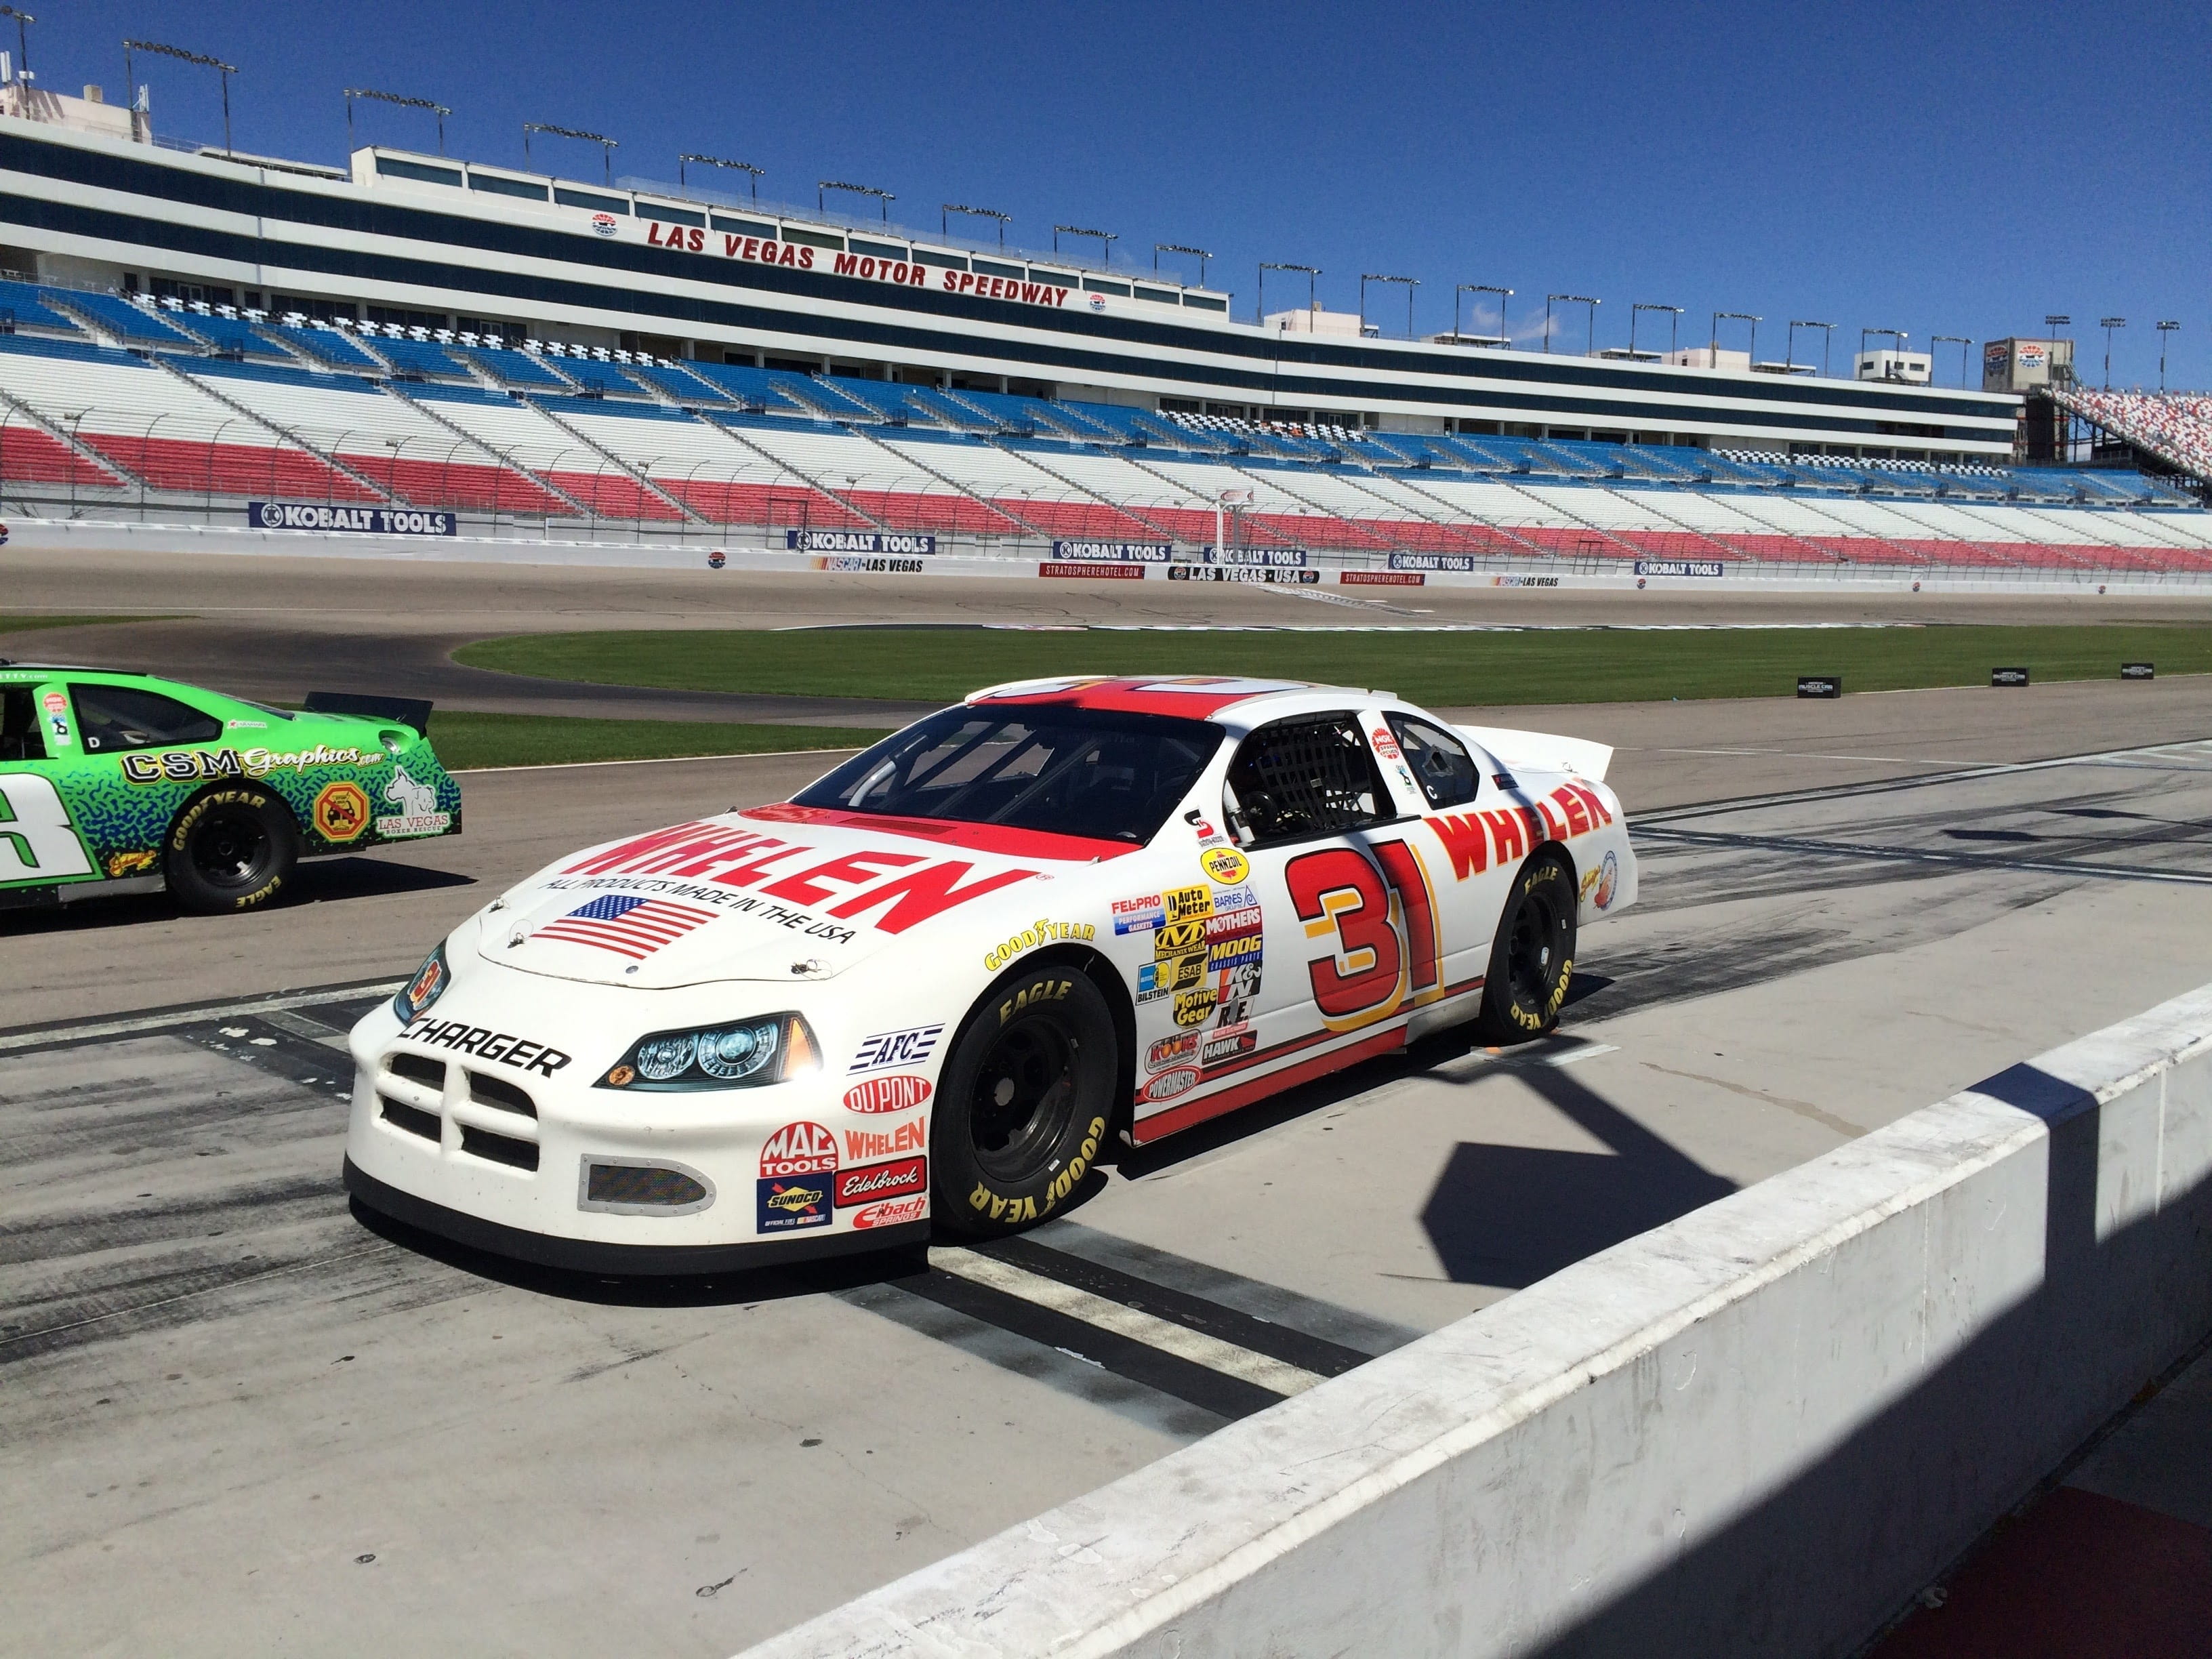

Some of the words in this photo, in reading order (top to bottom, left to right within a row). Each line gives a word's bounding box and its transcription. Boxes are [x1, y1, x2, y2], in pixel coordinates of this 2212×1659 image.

[648, 222, 705, 252] LAS
[724, 234, 815, 269] VEGAS
[833, 252, 926, 287] MOTOR
[943, 270, 1069, 308] SPEEDWAY
[285, 506, 373, 530] KOBALT
[380, 511, 447, 533] TOOLS
[813, 533, 875, 551] KOBALT
[881, 536, 928, 552] TOOLS
[1073, 544, 1123, 559] KOBALT
[1127, 546, 1166, 561] TOOLS
[1267, 551, 1301, 565] TOOLS
[888, 559, 923, 573] VEGAS
[1046, 565, 1140, 577] STRATOSPHEREHOTEL.COM
[1402, 556, 1439, 569] KOBALT
[1441, 557, 1470, 570] TOOLS
[1648, 562, 1686, 575] KOBALT
[1688, 565, 1719, 575] TOOLS
[1189, 567, 1216, 581] LAS
[1222, 567, 1267, 582] VEGAS
[1274, 569, 1300, 583] USA
[1536, 577, 1559, 587] VEGAS
[1374, 735, 1393, 744] NGK
[173, 790, 266, 851] GOODYEAR
[379, 819, 402, 830] LAS
[407, 815, 448, 827] VEGAS
[1422, 777, 1612, 882] WHELEN
[1209, 856, 1242, 873] PENNZOIL
[560, 821, 1042, 935] WHELEN
[1524, 865, 1559, 896] EAGLE
[236, 875, 282, 907] EAGLE
[1179, 889, 1203, 904] Auto
[1214, 893, 1242, 907] BARNES
[537, 879, 578, 889] ALL
[572, 878, 676, 891] PRODUCTS
[665, 884, 739, 904] MADE
[729, 897, 766, 912] IN
[758, 905, 813, 928] THE
[804, 922, 857, 944] USA
[1111, 895, 1161, 914] FEL-PRO
[1179, 901, 1210, 918] Meter
[1119, 910, 1160, 925] PERFORMANCE
[1128, 920, 1153, 932] GASKETS
[1206, 908, 1261, 935] MOTHERS
[1284, 839, 1440, 1018] 31
[984, 919, 1095, 972] GOODYEAR
[1187, 941, 1206, 954] WEAR
[1210, 935, 1263, 962] MOOG
[1210, 957, 1237, 971] CHASSIS
[1241, 952, 1260, 963] PARTS
[1178, 964, 1202, 979] ESAB
[999, 980, 1073, 1027] EAGLE
[1138, 987, 1169, 1002] BILSTEIN
[1174, 988, 1218, 1011] Motive
[1177, 1005, 1211, 1026] Gear
[397, 1017, 573, 1078] CHARGER
[1151, 1032, 1199, 1063] KOOKS
[1204, 1036, 1240, 1059] HAWK
[1148, 1071, 1196, 1098] POWERMASTER
[763, 1124, 834, 1162] MAC
[844, 1115, 926, 1161] WHELEN
[762, 1157, 836, 1175] TOOLS
[969, 1116, 1106, 1223] GOODYEAR
[842, 1166, 919, 1197] Edelbrock
[771, 1191, 820, 1206] SUNOCO
[872, 1211, 918, 1227] SPRINGS
